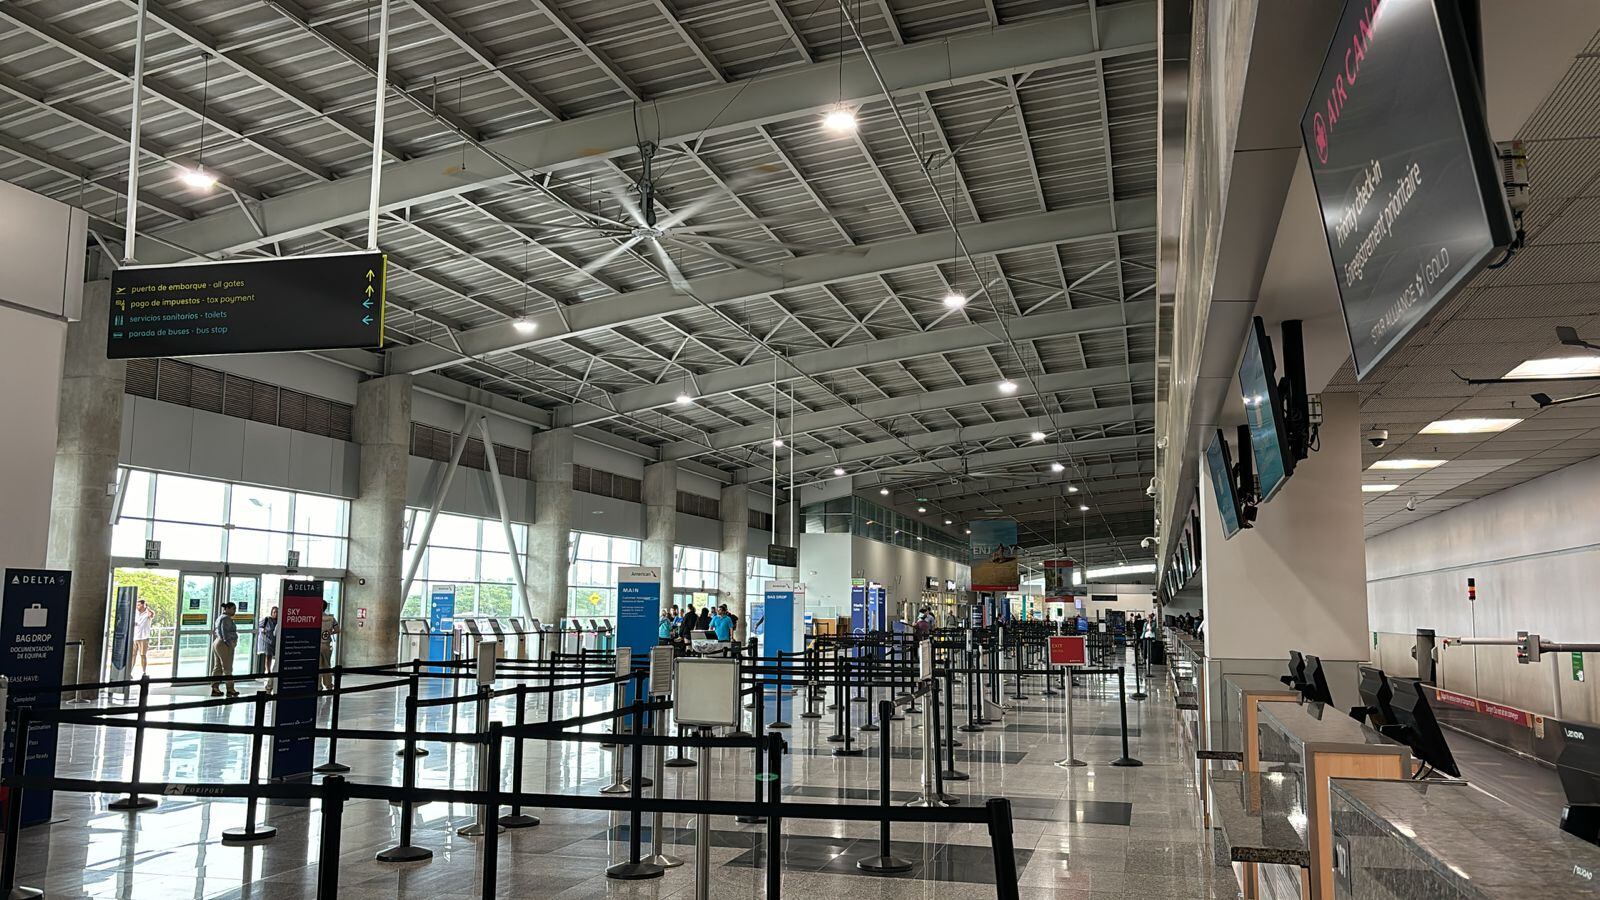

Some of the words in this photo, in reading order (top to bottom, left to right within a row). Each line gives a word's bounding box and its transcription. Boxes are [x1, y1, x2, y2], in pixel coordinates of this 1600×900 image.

[1328, 74, 1348, 133] AIR
[1336, 203, 1358, 248] Priority
[1356, 159, 1382, 216] check-in
[1344, 212, 1387, 287] Enregistrement
[1384, 162, 1422, 238] prioritaire
[131, 284, 156, 294] puerta
[157, 284, 167, 292] de
[168, 282, 207, 292] embarque
[212, 280, 222, 289] all
[223, 280, 245, 290] gates
[130, 300, 150, 309] pago
[162, 297, 201, 307] impuestos
[220, 294, 255, 304] payment
[1370, 317, 1387, 345] STAR
[1384, 282, 1417, 328] ALLIANCE
[1425, 247, 1450, 284] GOLD
[129, 314, 161, 323] servicios
[162, 312, 199, 321] sanitarios
[205, 311, 227, 319] toilets
[128, 329, 156, 339] parada
[157, 327, 167, 336] de
[168, 326, 190, 335] buses
[196, 325, 209, 334] bus
[211, 325, 228, 335] stop
[23, 575, 55, 584] DELTA
[286, 615, 316, 624] PRIORITY
[16, 634, 31, 643] BAG
[32, 634, 52, 642] DROP
[10, 645, 54, 653] DOCUMENTACIÓN
